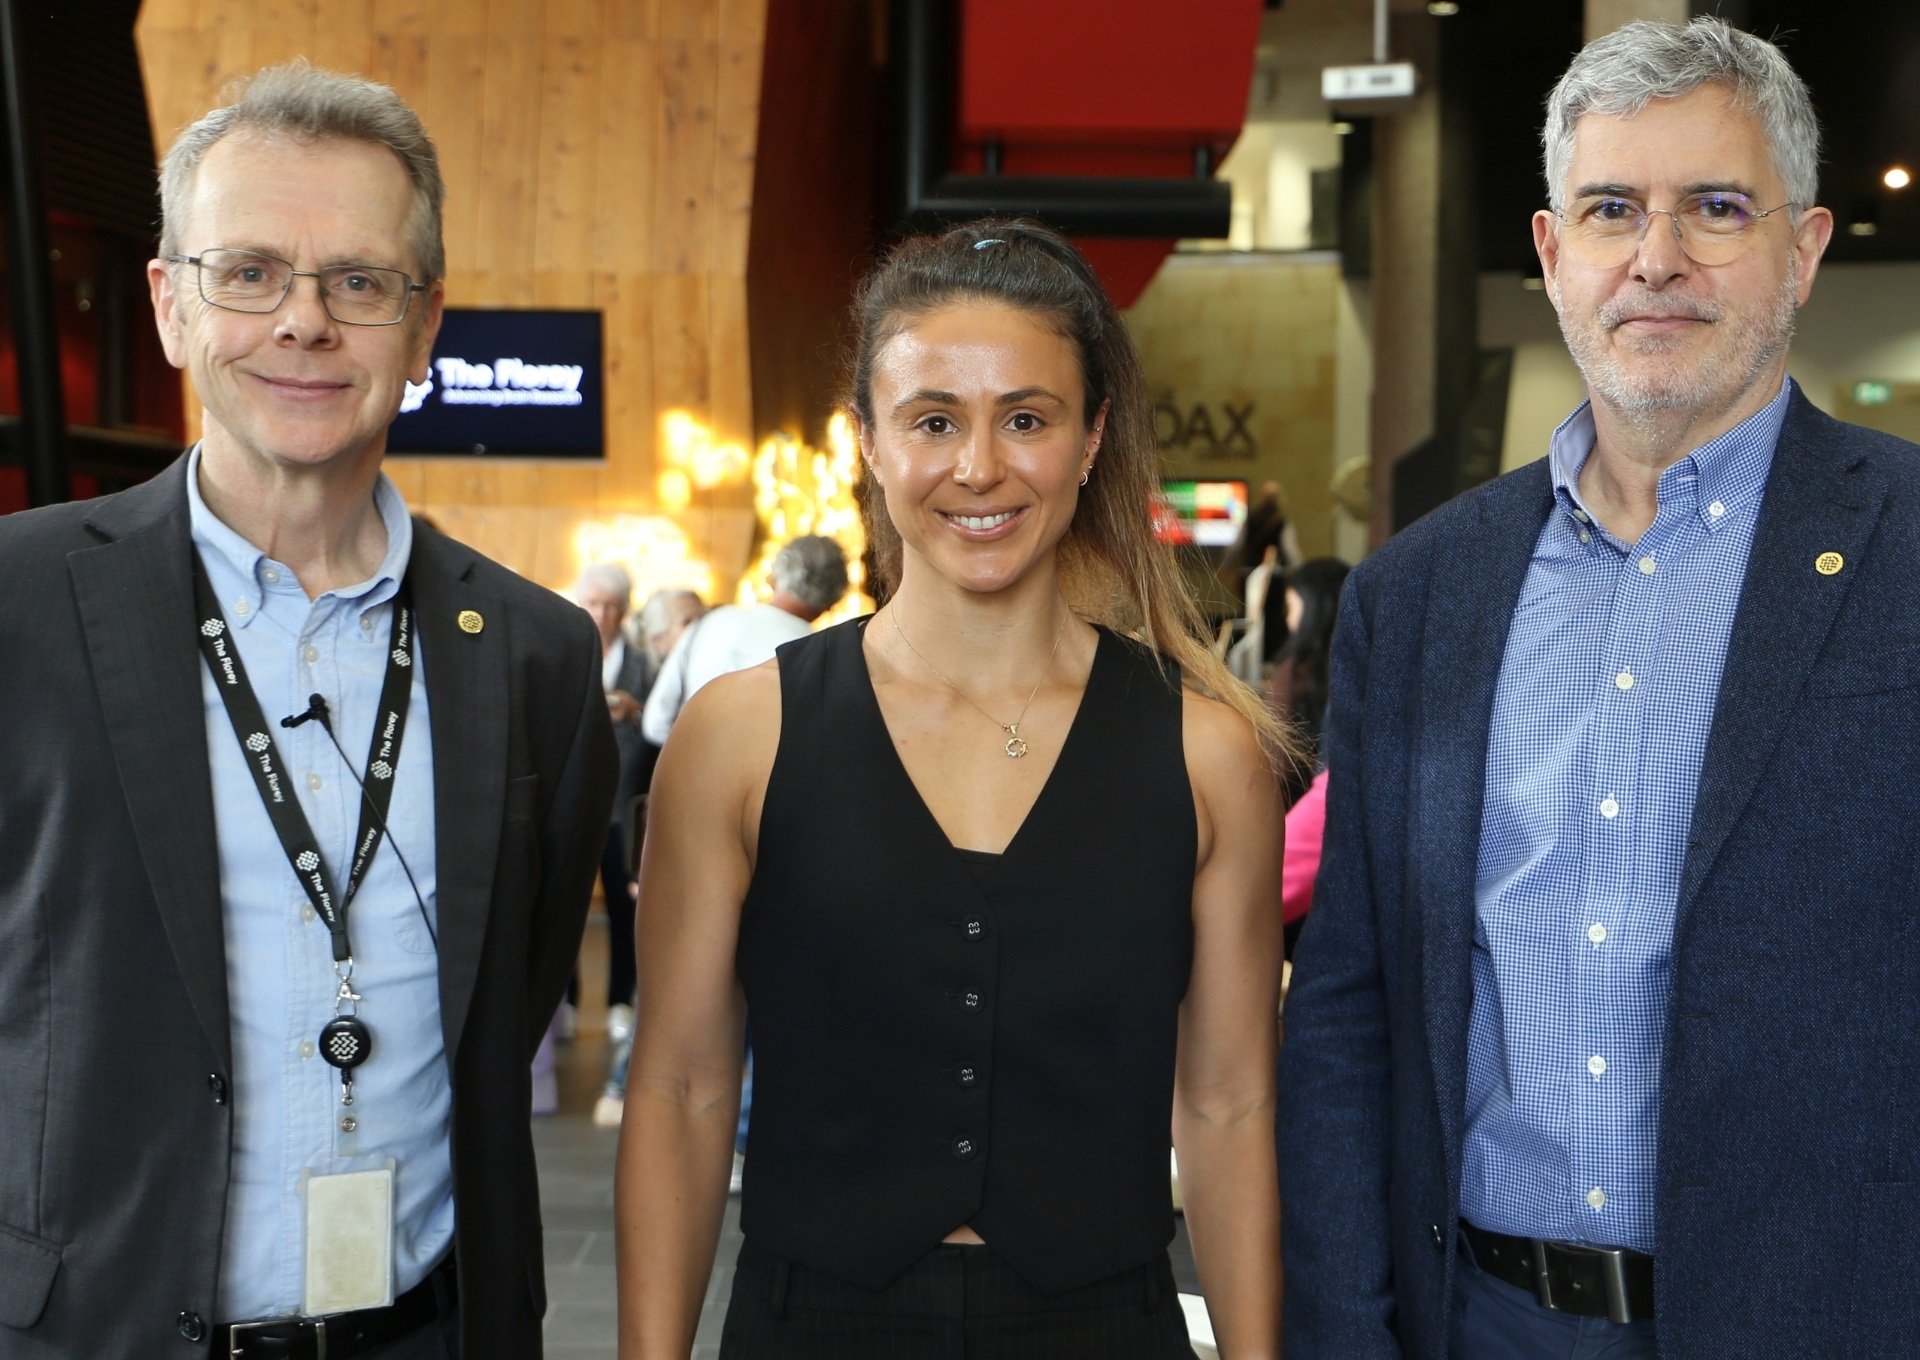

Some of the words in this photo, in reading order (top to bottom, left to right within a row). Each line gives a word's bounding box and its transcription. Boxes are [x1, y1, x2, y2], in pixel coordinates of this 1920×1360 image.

[436, 358, 494, 388] The
[399, 632, 408, 648] The
[213, 638, 226, 657] The
[220, 657, 238, 685] Florey
[383, 712, 399, 740] Florey
[380, 740, 392, 757] The
[259, 753, 272, 772] The
[267, 773, 284, 802] Florey
[353, 858, 364, 874] The
[360, 828, 377, 857] Florey
[310, 872, 324, 892] The
[320, 893, 336, 922] Florey
